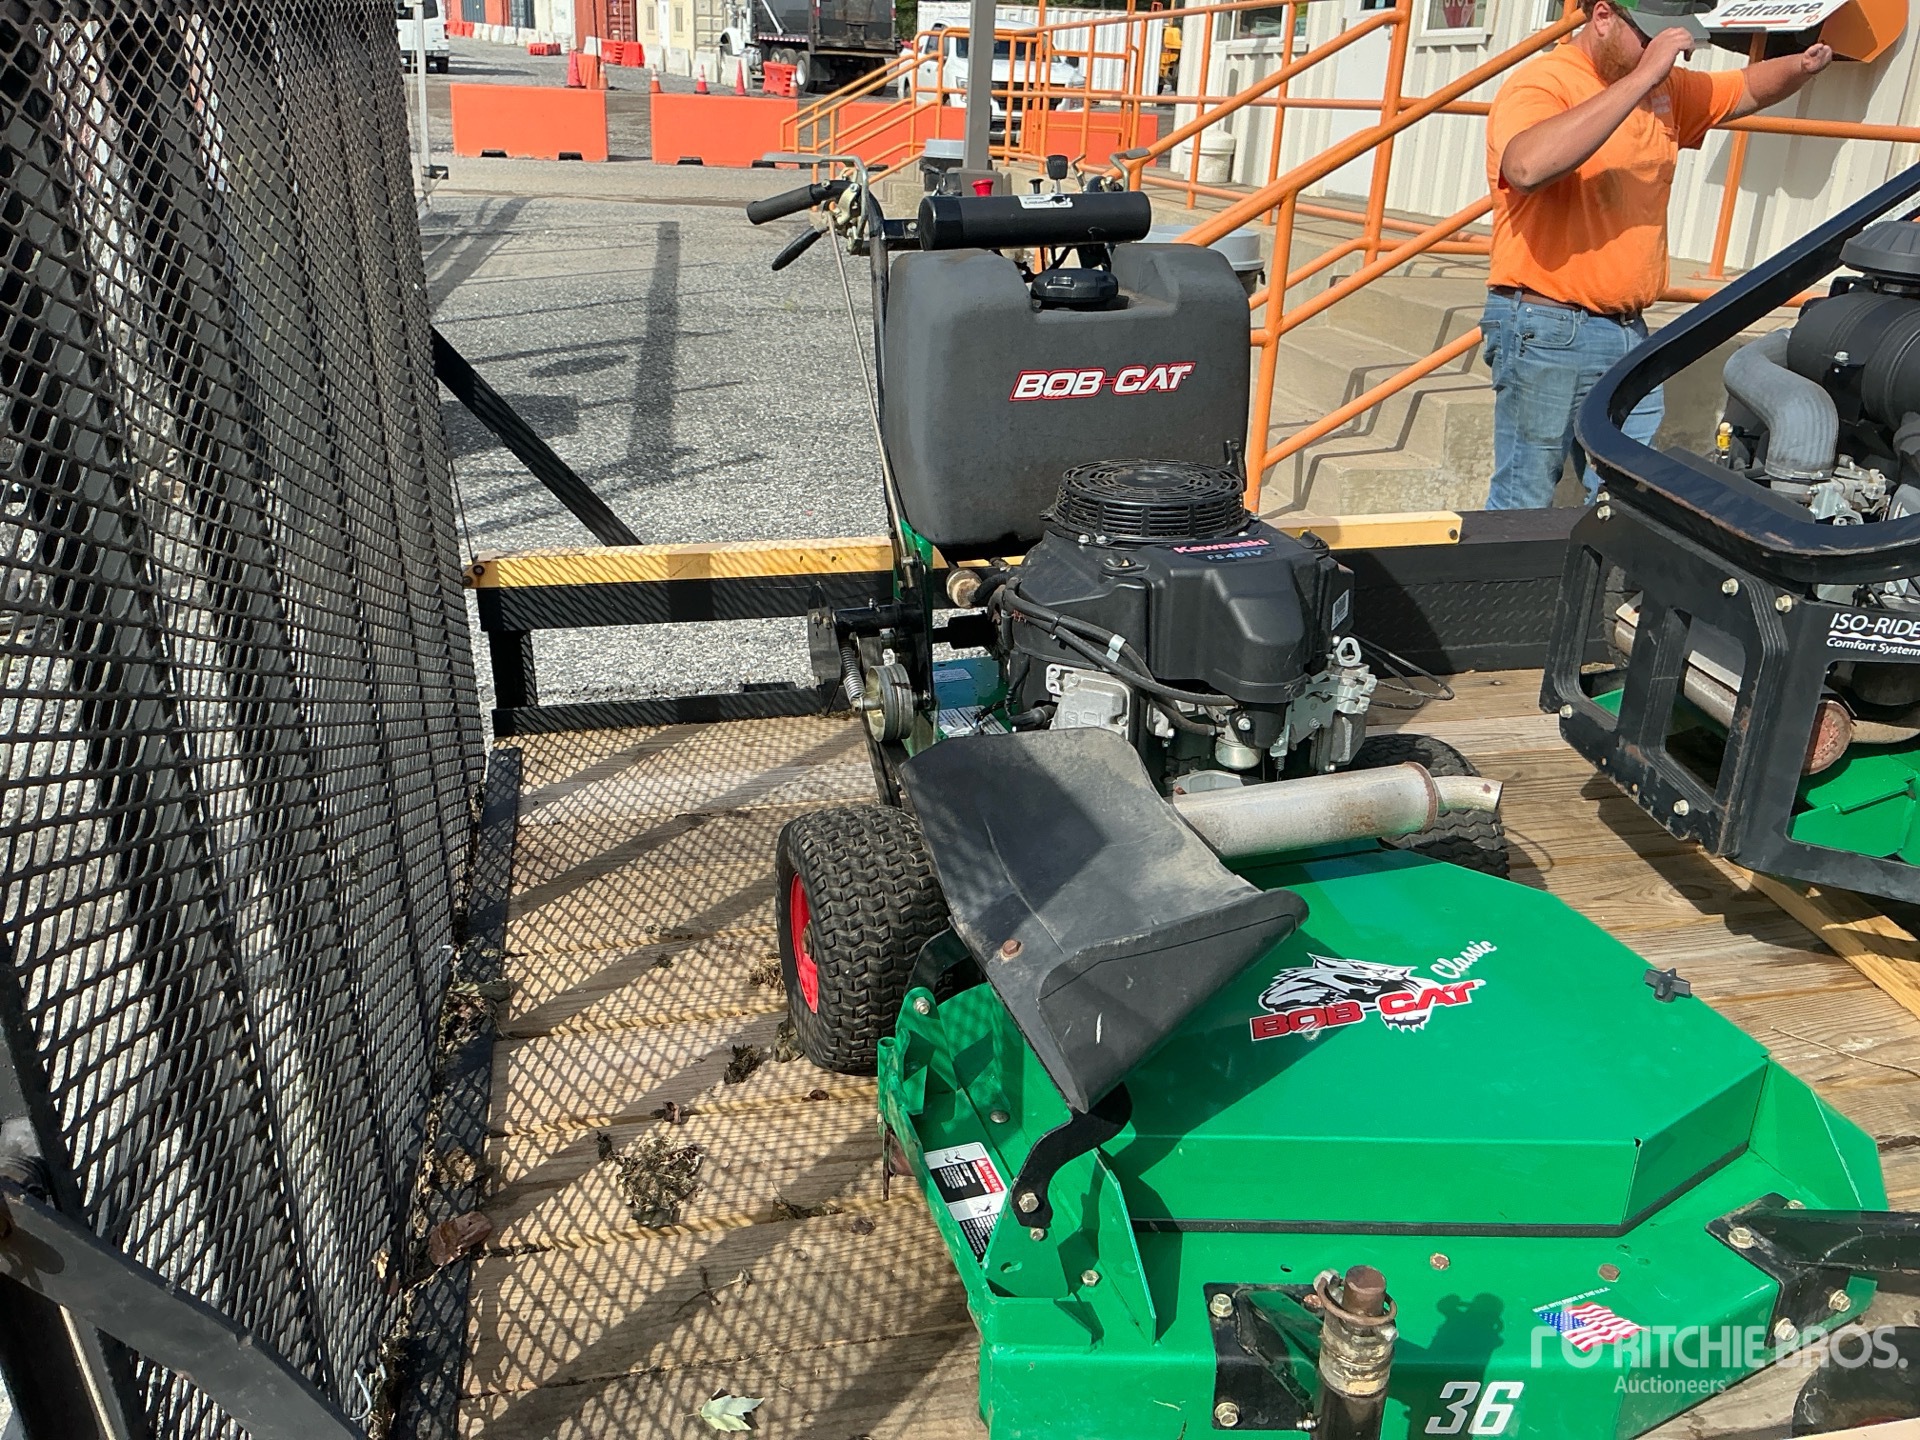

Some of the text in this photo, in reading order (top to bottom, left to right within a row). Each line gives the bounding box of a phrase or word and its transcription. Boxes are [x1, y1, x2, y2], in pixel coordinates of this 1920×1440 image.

[1720, 2, 1824, 18] Entrance
[1173, 539, 1270, 554] Kawasaki
[1829, 612, 1920, 638] ISO-RIDE
[1826, 637, 1877, 651] Comfort
[1430, 940, 1497, 979] Classic
[1424, 1381, 1525, 1434] 36
